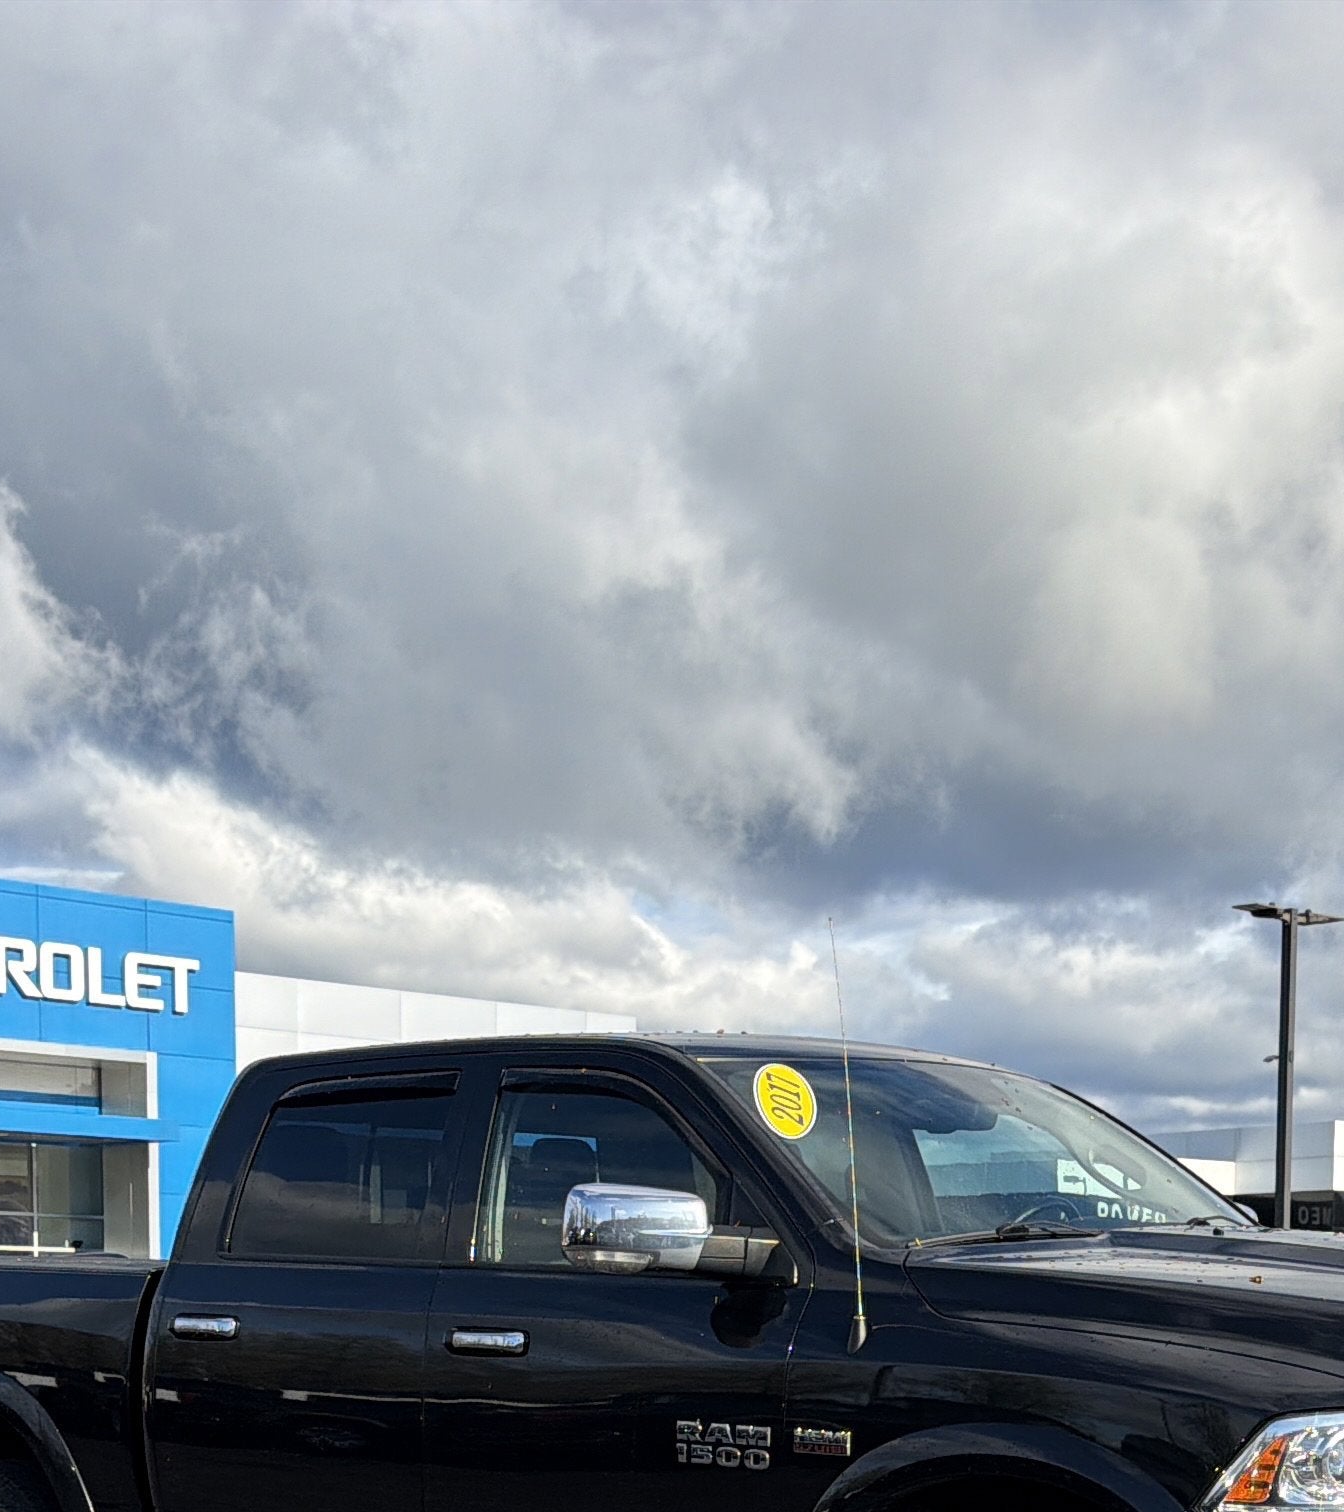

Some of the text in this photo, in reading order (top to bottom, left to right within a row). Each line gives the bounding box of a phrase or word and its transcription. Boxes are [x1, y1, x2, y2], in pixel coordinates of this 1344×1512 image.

[766, 1071, 804, 1126] 2017
[676, 1419, 771, 1447] RAM
[675, 1443, 771, 1470] 1500
